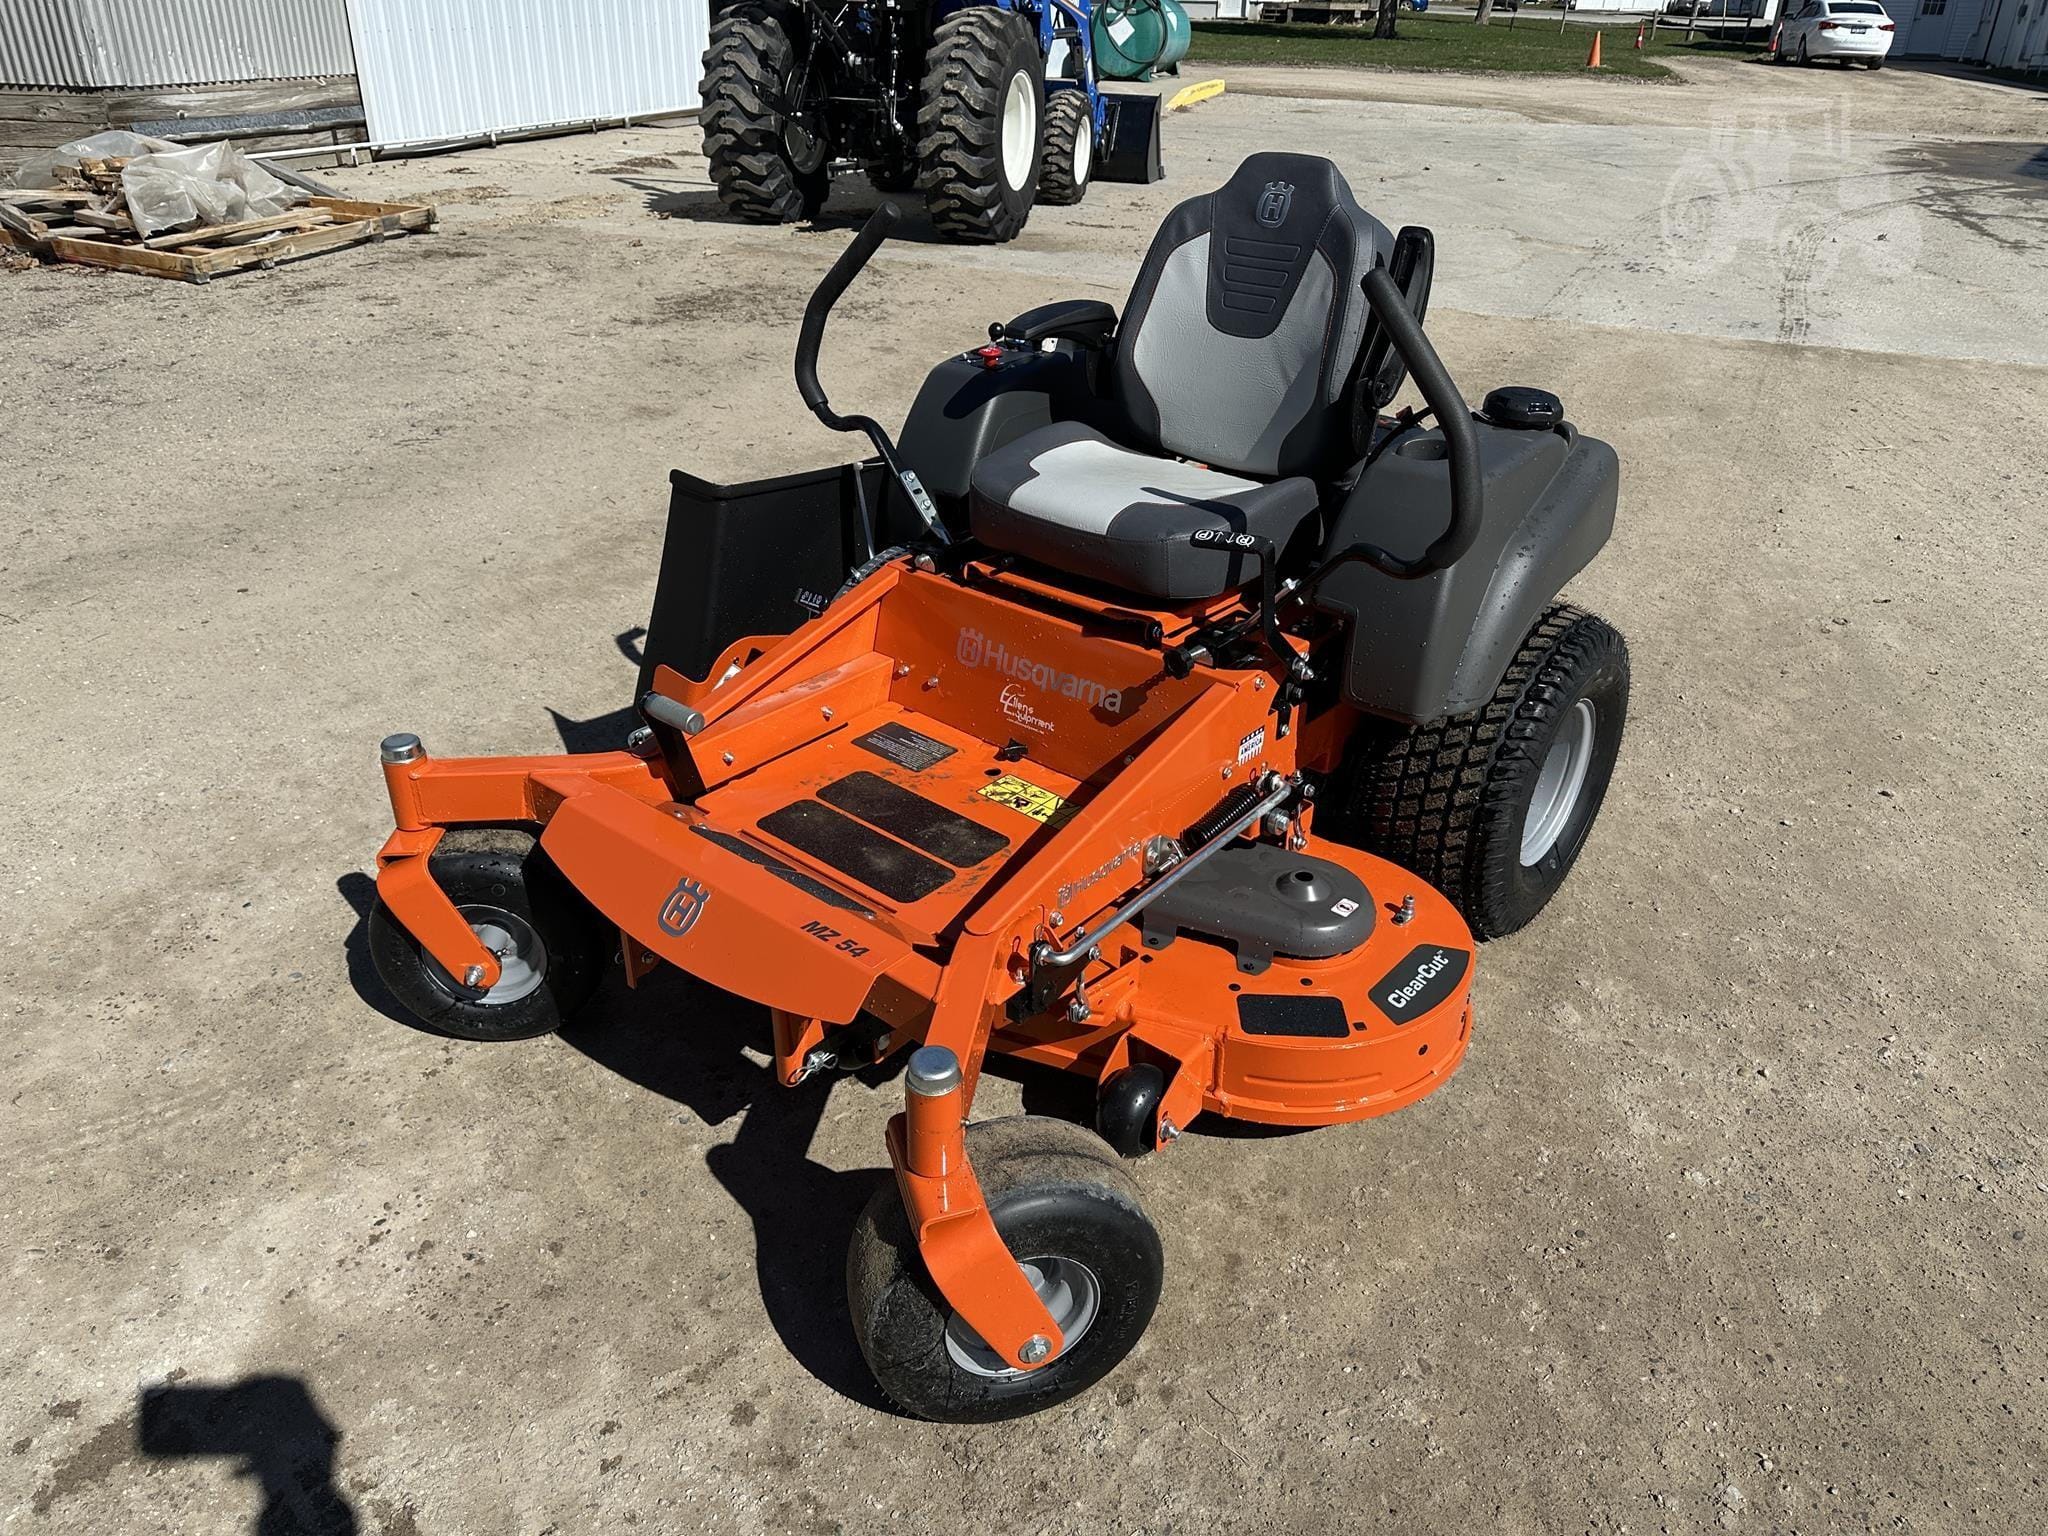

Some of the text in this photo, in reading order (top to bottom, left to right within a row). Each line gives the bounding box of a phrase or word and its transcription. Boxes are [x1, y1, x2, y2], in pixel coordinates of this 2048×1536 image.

[984, 639, 1122, 713] Husqvarna
[800, 920, 871, 958] MZ 54
